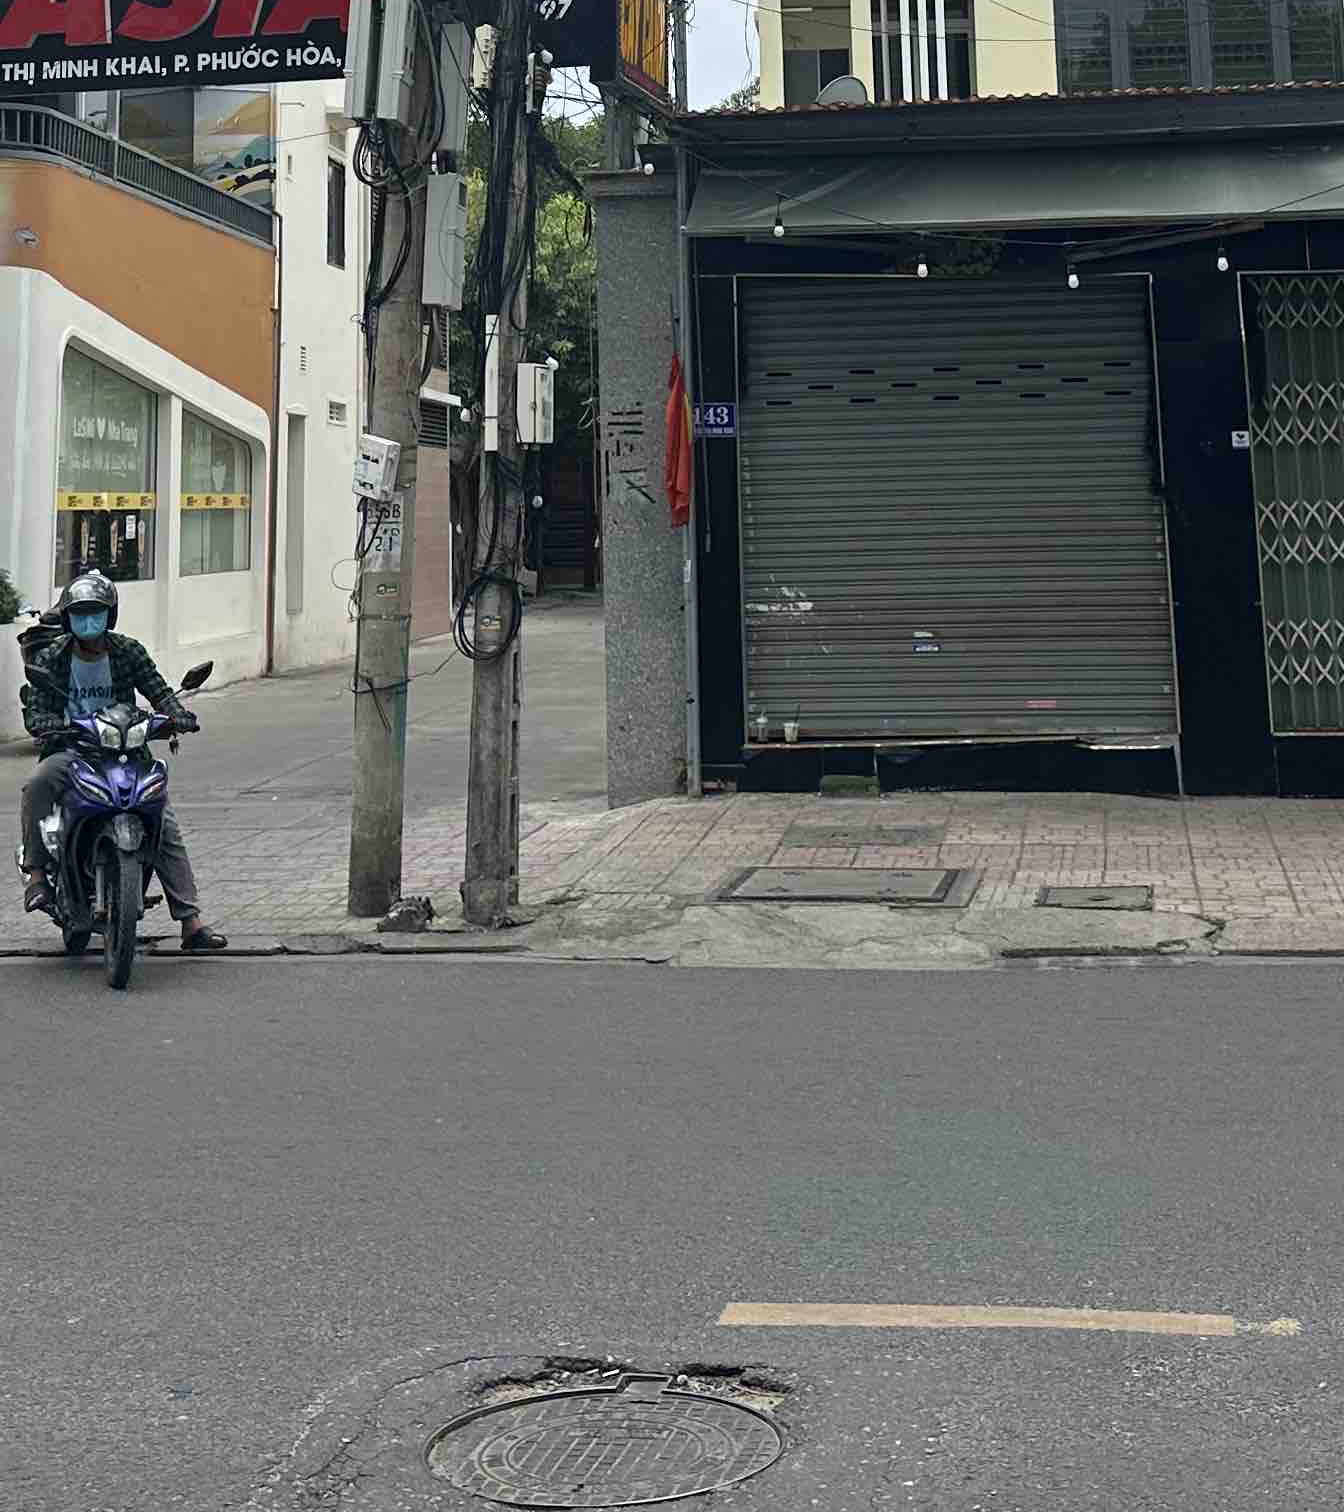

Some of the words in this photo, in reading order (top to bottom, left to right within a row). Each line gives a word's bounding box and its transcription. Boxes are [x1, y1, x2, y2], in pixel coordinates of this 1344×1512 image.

[2, 62, 36, 85] THỊ
[42, 59, 98, 81] MINH
[105, 55, 167, 78] KHAI,
[173, 54, 191, 74] P.
[197, 46, 280, 72] PHƯỚC
[286, 40, 343, 68] HÒA,
[694, 405, 729, 425] 143
